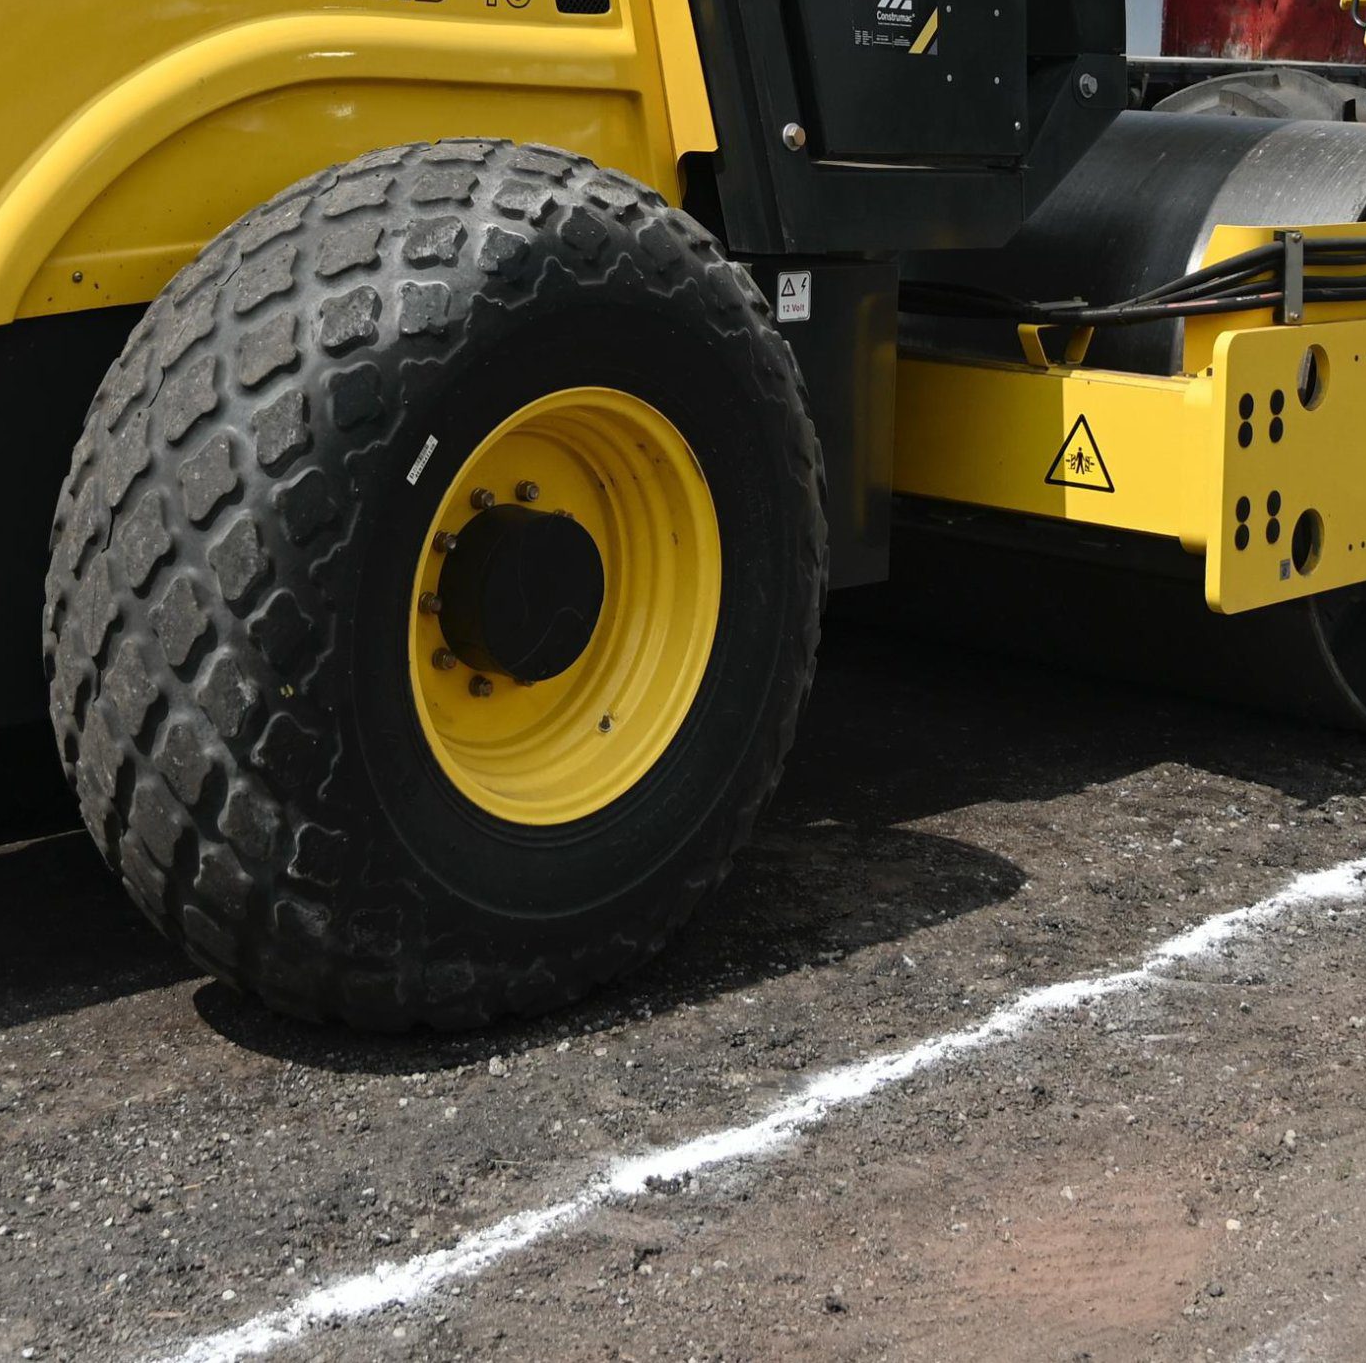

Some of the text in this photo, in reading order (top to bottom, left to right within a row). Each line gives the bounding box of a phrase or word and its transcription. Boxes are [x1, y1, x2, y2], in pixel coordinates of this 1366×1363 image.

[876, 10, 913, 23] Construmac
[782, 303, 805, 313] 12 Volt
